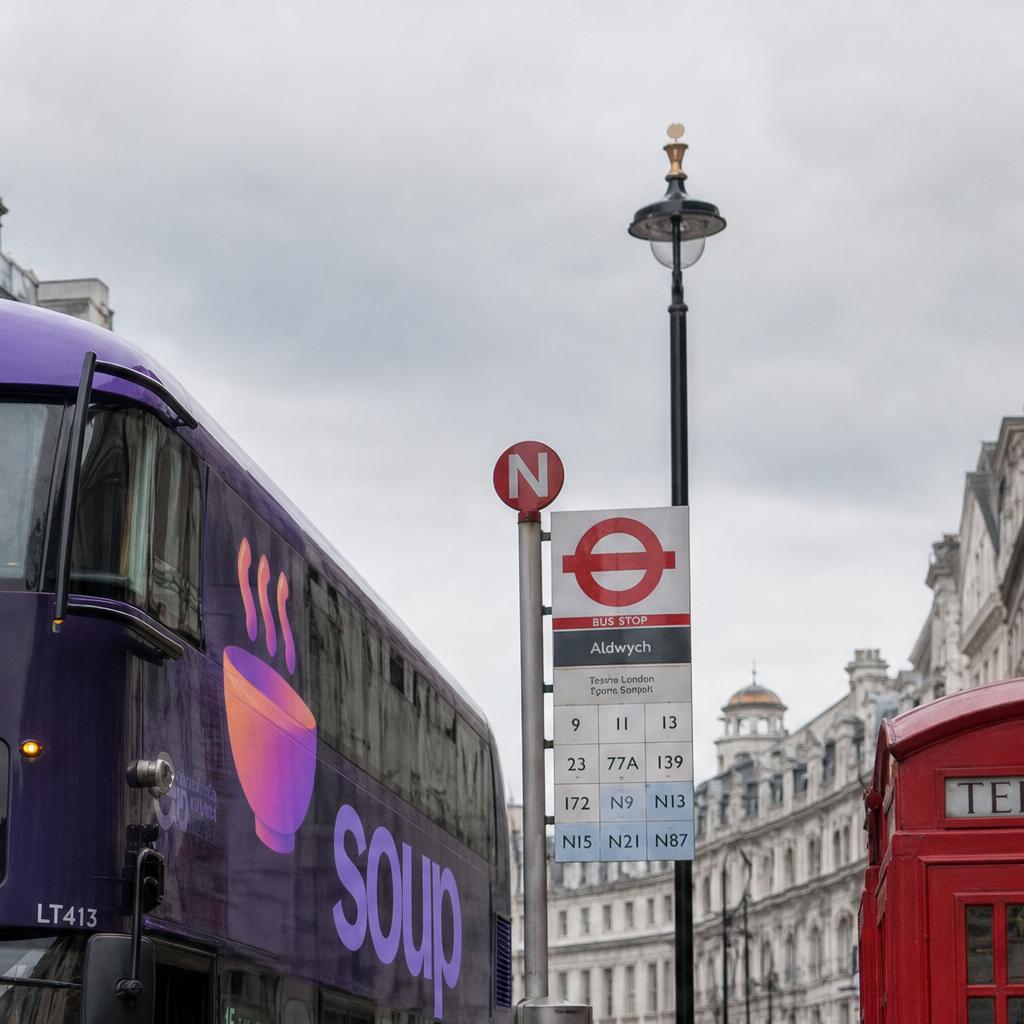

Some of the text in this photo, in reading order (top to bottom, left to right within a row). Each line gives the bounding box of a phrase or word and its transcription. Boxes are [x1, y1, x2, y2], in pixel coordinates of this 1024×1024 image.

[508, 452, 549, 498] N
[593, 615, 647, 627] BUS STOP
[590, 640, 651, 656] Aldwych
[621, 674, 655, 684] London
[571, 716, 677, 732] 9 11 13
[567, 755, 683, 771] 23 77A 139
[565, 794, 686, 810] 172 N9 N13
[562, 833, 688, 848] N15 N21 N87
[38, 903, 97, 928] LT413
[332, 804, 462, 1019] soup
